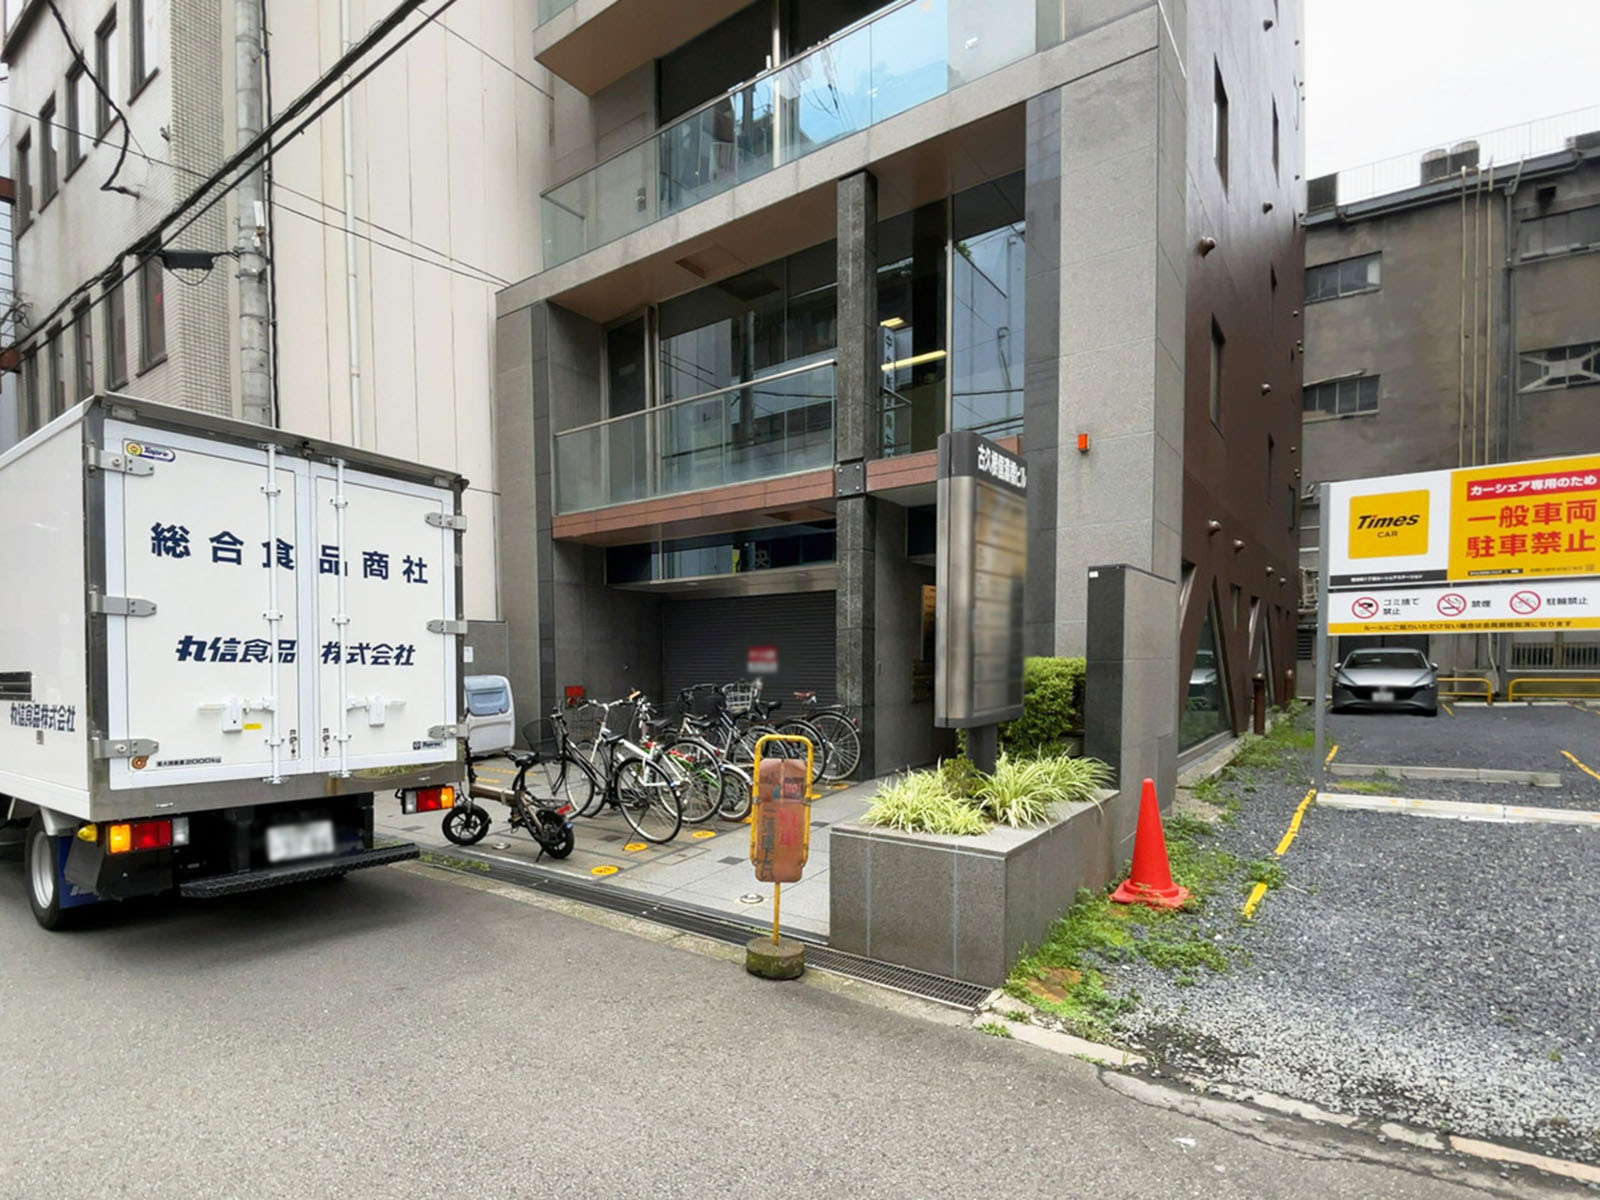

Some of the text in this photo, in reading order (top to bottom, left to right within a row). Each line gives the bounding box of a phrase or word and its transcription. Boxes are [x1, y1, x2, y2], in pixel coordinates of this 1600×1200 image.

[1470, 474, 1598, 497] カーシェア専用のため
[1356, 513, 1420, 531] Times
[1467, 499, 1598, 529] 一般車両
[1377, 530, 1399, 539] CAR
[1466, 529, 1597, 559] 駐車禁止
[151, 521, 429, 585] 総合食品商社
[1383, 598, 1420, 606] ゴミ捨て
[1383, 607, 1401, 616] 禁止
[1471, 600, 1492, 608] 禁煙
[1546, 597, 1589, 606] 駐輪禁止
[175, 635, 416, 667] 丸信食品 株式会社
[10, 702, 76, 732] 丸信食品株式会社
